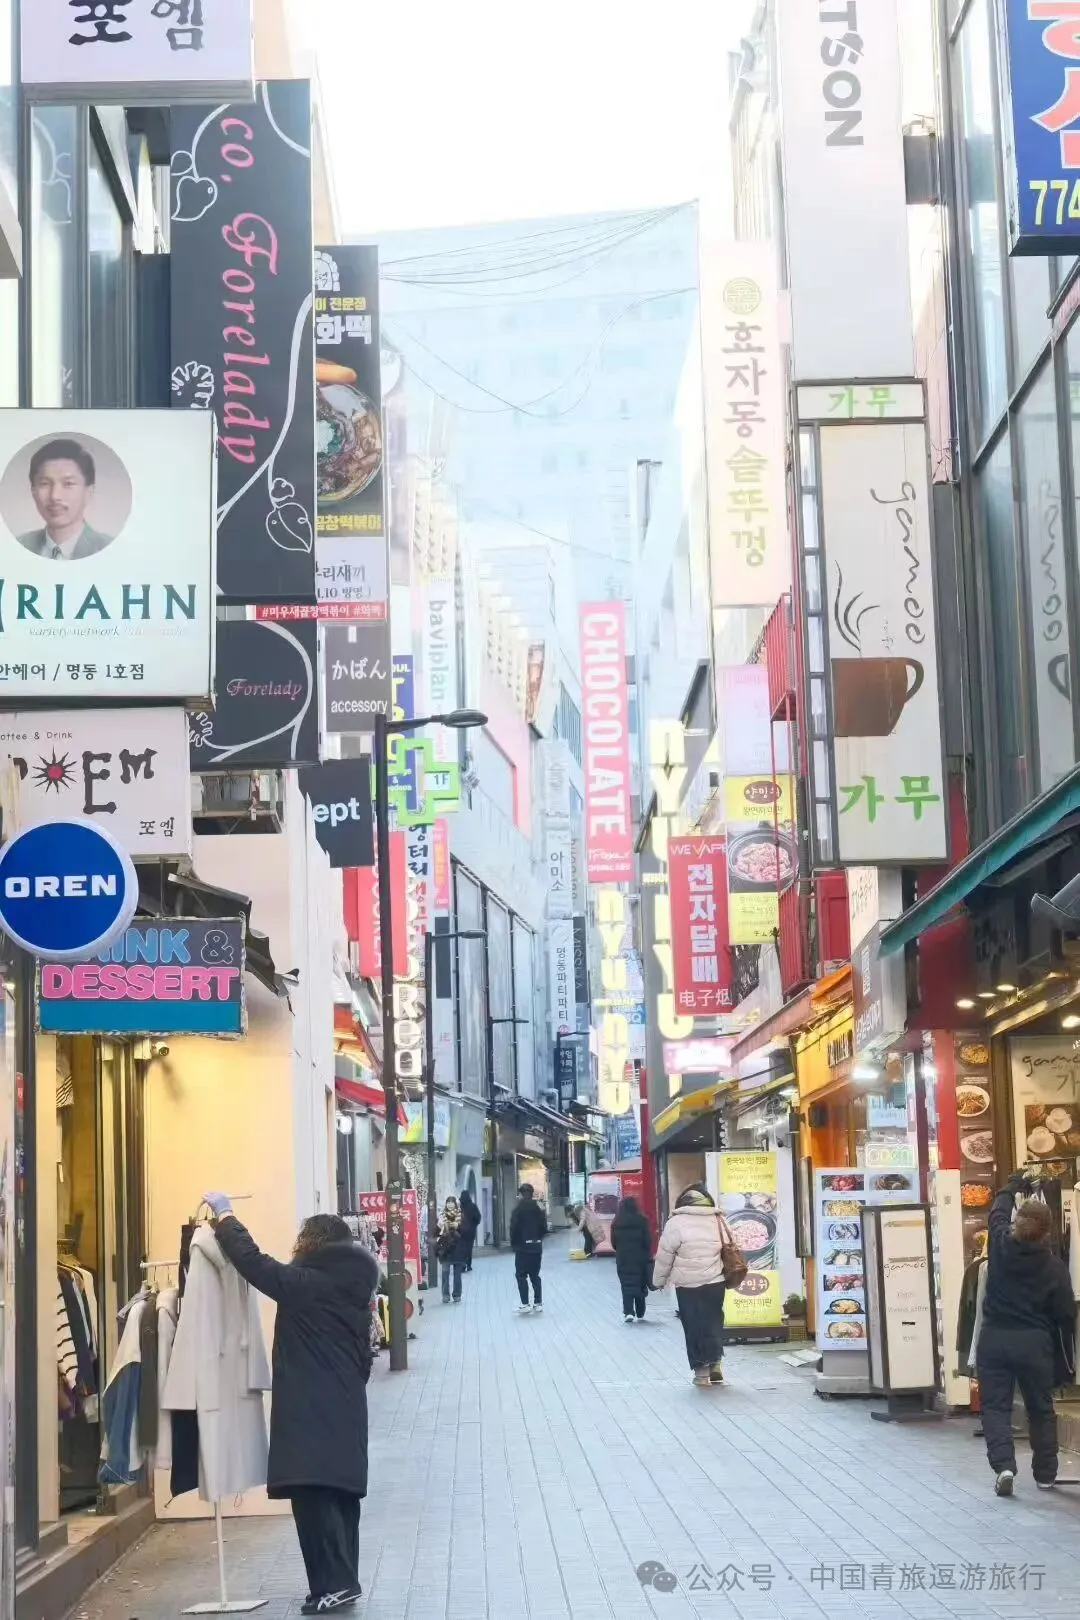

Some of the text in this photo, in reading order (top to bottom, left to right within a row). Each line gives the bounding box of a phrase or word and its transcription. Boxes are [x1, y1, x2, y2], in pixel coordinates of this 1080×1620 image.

[218, 212, 279, 464] Forelady
[828, 386, 898, 418] 가무
[16, 584, 197, 620] RIAHN
[66, 663, 98, 681] 명동
[106, 663, 145, 681] 1호점
[226, 678, 303, 700] Forelady
[330, 698, 389, 715] accessory
[46, 730, 73, 740] Drink
[583, 612, 628, 838] CHOCOLATE
[838, 775, 942, 823] 가무
[138, 816, 175, 838] 포엠
[4, 874, 117, 899] OREN
[686, 863, 720, 984] 전자담배
[200, 929, 235, 965] &
[41, 964, 239, 1001] DESSERT
